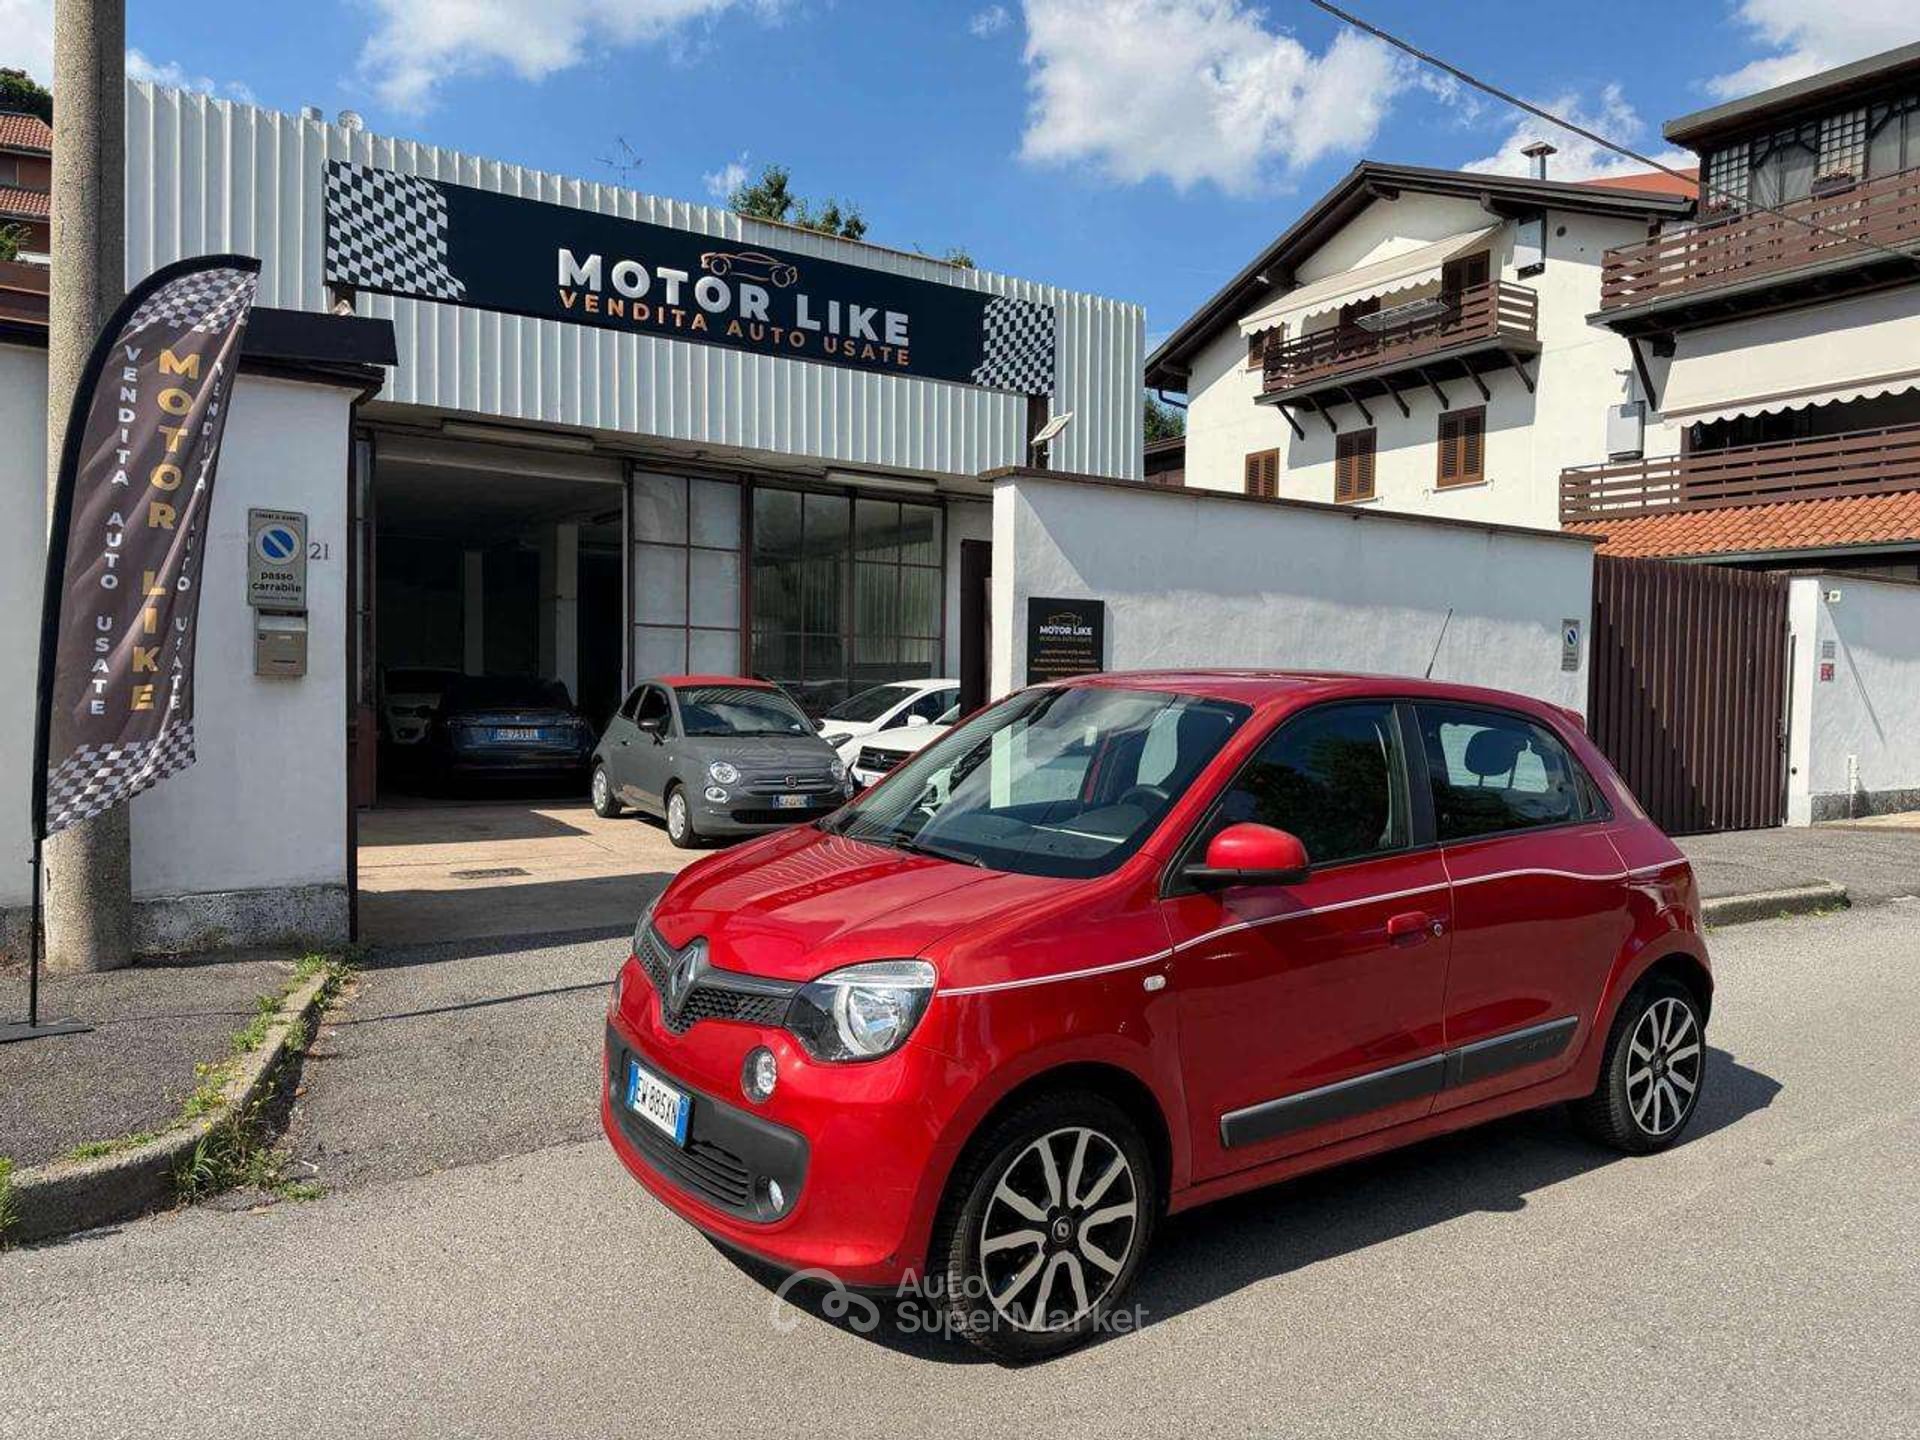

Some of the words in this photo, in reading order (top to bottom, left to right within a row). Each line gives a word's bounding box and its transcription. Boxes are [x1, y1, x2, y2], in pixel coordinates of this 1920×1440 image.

[558, 248, 770, 322] MOTOR
[796, 294, 910, 347] LIKE
[559, 289, 708, 331] VENDITA
[727, 319, 806, 347] AUTO
[823, 336, 910, 366] USATE
[111, 345, 142, 486] VENDITA
[148, 348, 200, 530] MOTOR
[100, 511, 125, 590] AUTO
[251, 581, 302, 593] carrabile
[260, 571, 294, 582] passo
[309, 543, 329, 560] 21
[90, 616, 111, 715] USATE
[130, 570, 167, 711] LIKE
[1039, 625, 1073, 635] MOTOR
[1073, 625, 1093, 636] LIKE
